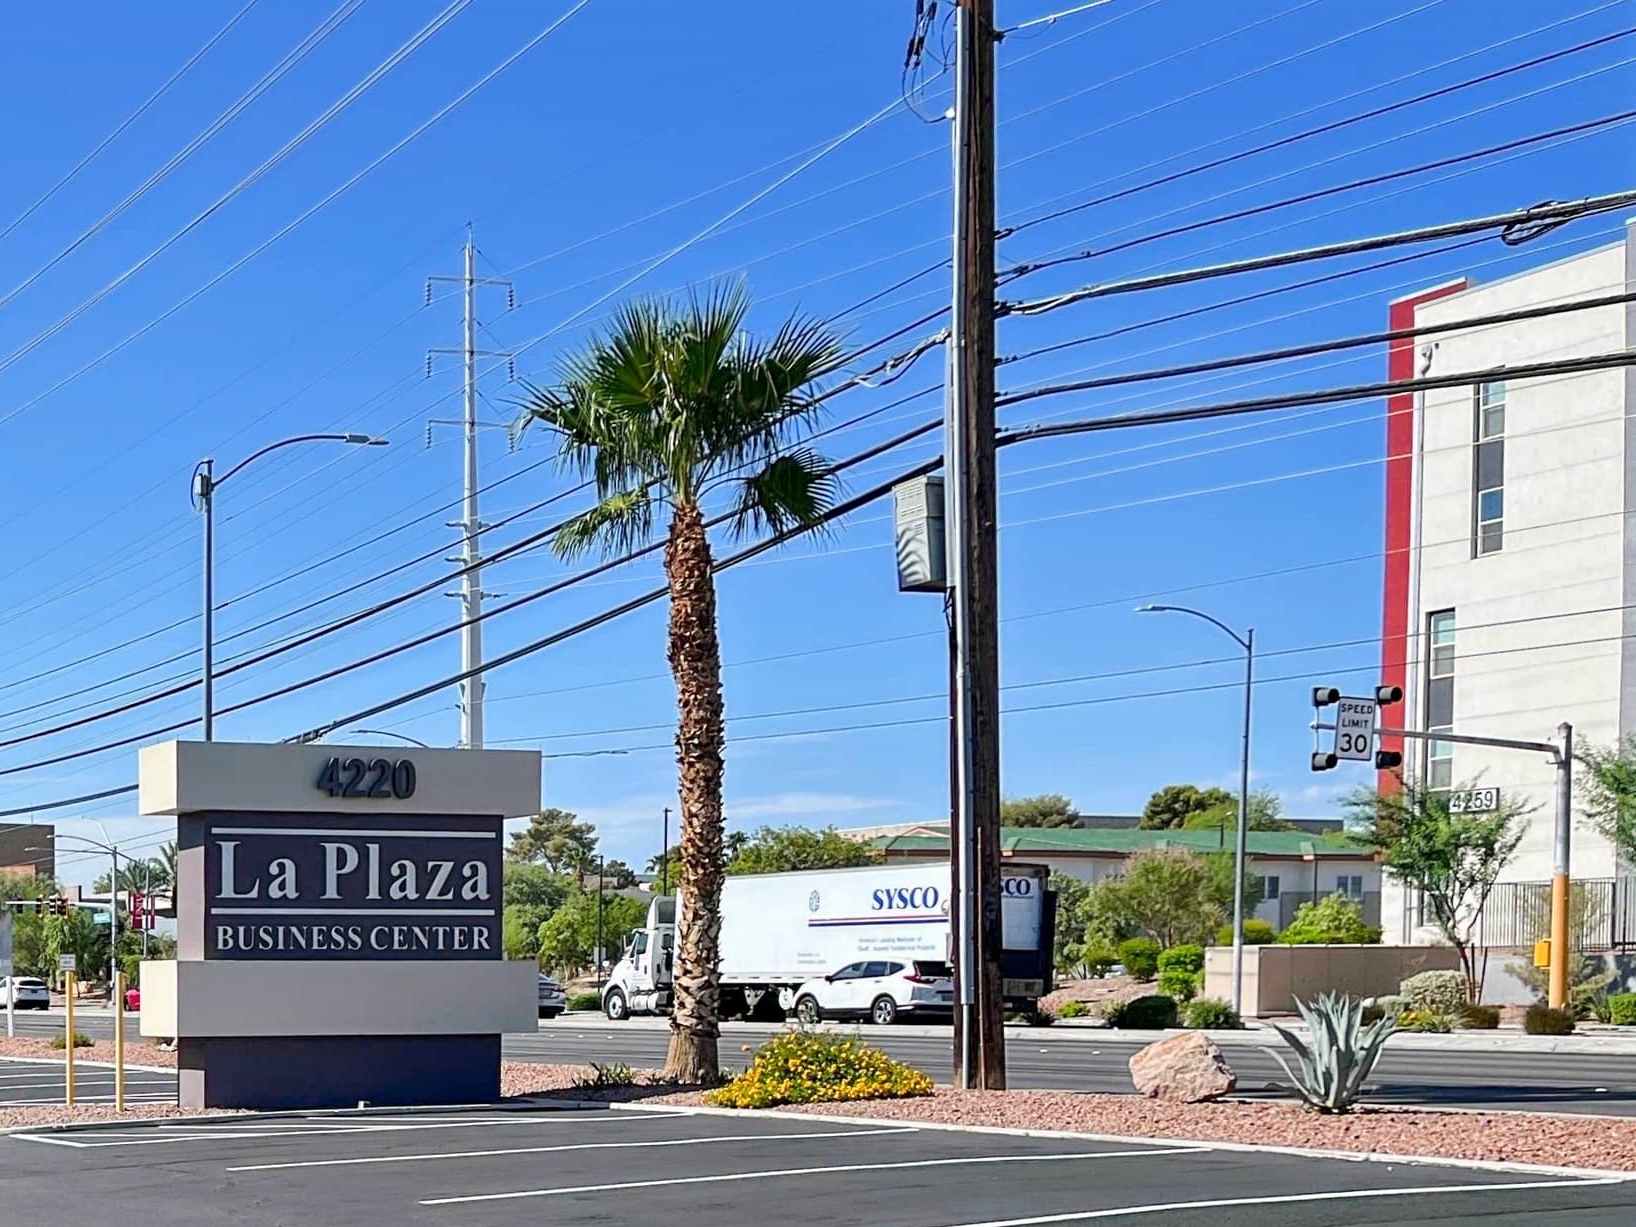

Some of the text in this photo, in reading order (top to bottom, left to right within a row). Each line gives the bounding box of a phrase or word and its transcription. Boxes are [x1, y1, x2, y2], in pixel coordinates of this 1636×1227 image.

[1340, 703, 1373, 715] SPEED
[1341, 718, 1369, 729] LIMIT
[1339, 732, 1367, 753] 30
[316, 756, 417, 800] 4220
[1452, 790, 1493, 809] 4259
[214, 840, 492, 901] La Plaza
[871, 886, 939, 911] SYSCO
[216, 925, 492, 951] BUSINESS CENTER
